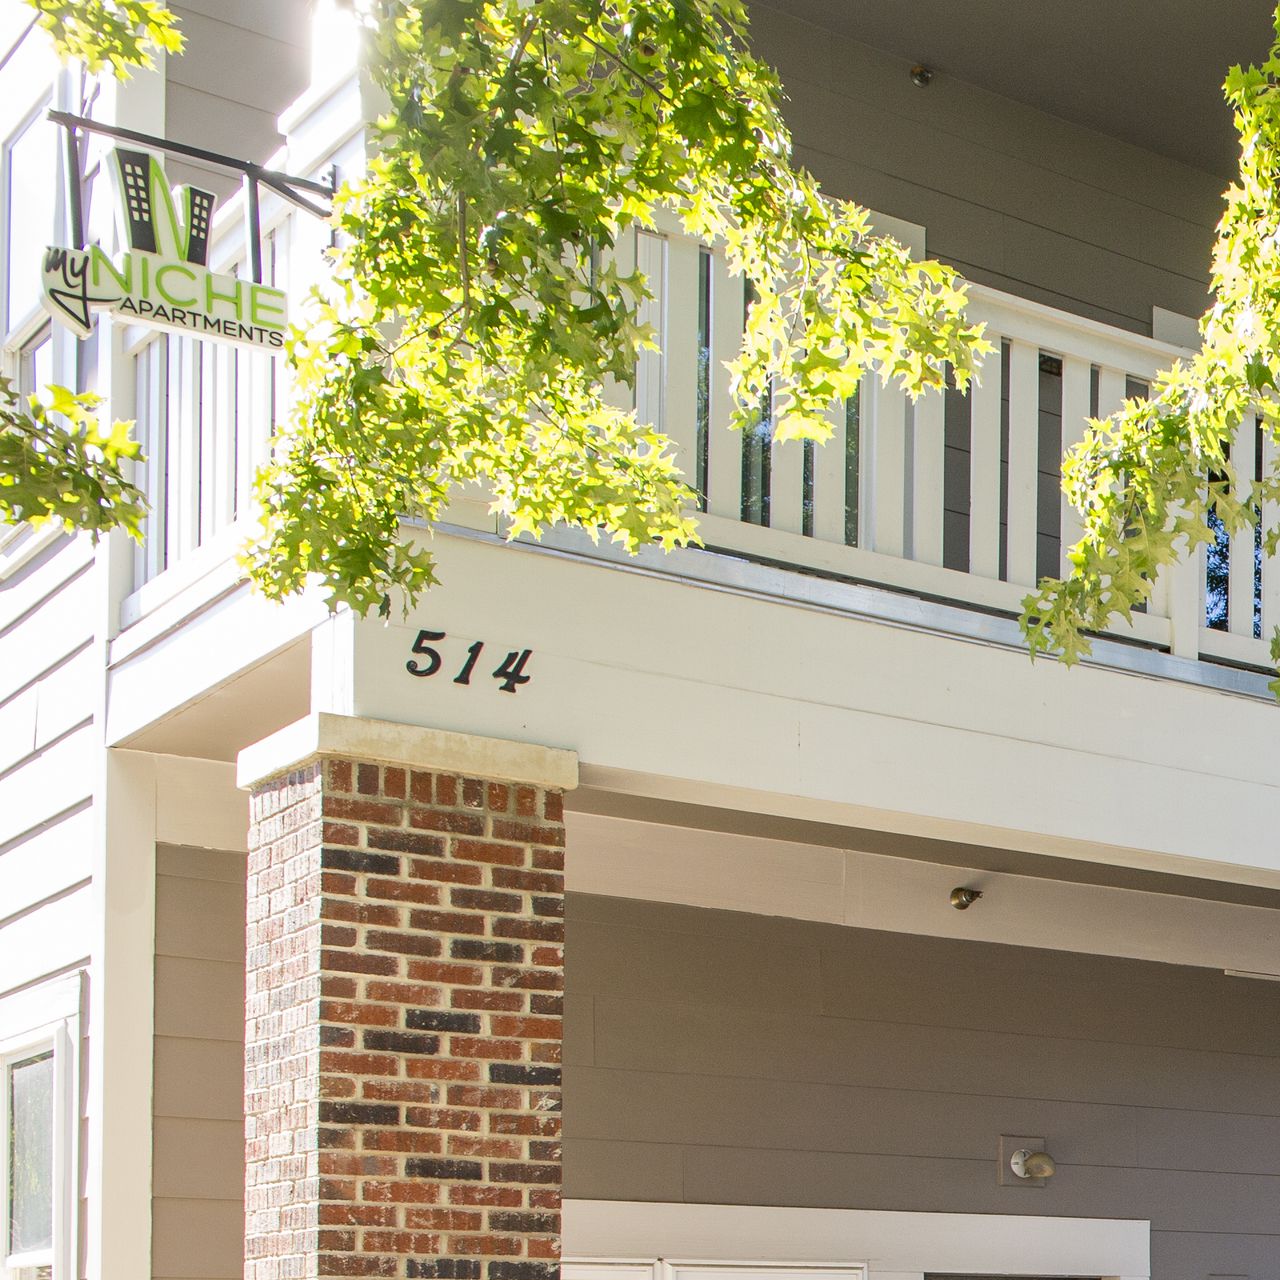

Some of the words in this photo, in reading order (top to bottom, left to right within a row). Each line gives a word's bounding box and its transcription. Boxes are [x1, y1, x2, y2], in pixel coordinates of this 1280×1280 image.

[89, 245, 287, 330] NICHE
[119, 296, 284, 347] APARTMENTS
[406, 629, 533, 693] 514
